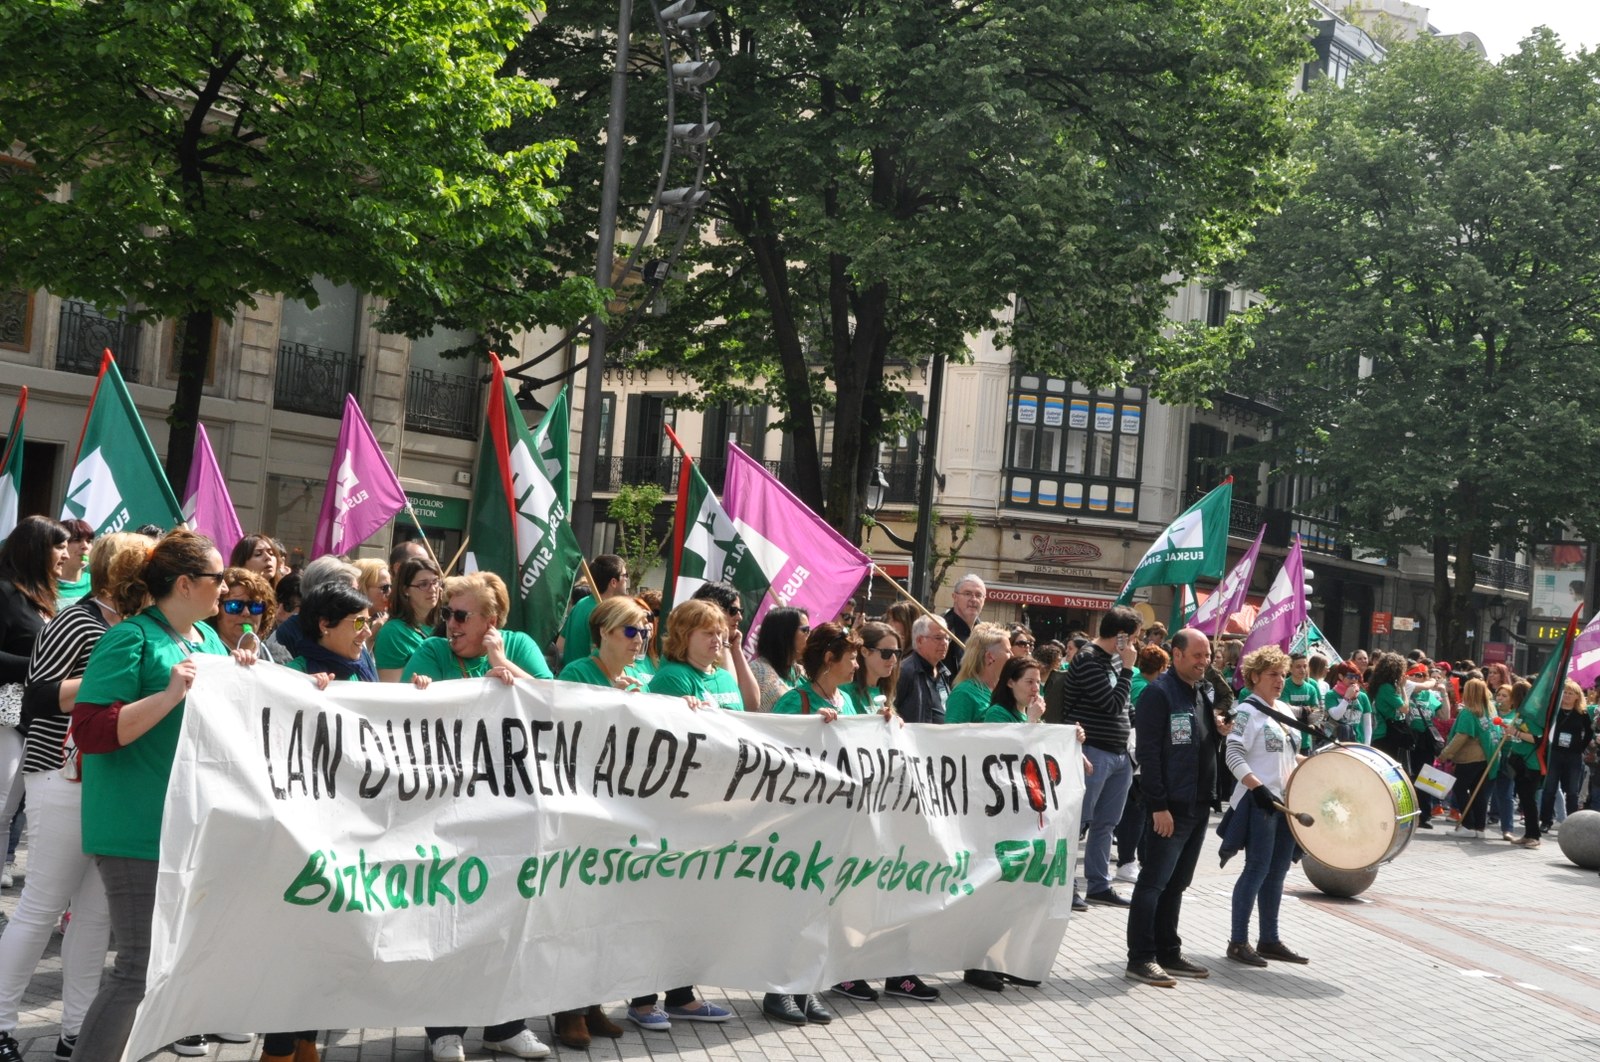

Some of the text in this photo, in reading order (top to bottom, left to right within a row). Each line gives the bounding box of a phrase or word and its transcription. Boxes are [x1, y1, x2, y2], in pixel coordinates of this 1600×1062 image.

[419, 498, 444, 509] COLORS
[988, 591, 1051, 604] GOZOTEGIA
[262, 707, 342, 800] LAN
[359, 717, 582, 801] DUINAREN
[592, 724, 706, 799] ALDE
[982, 753, 1062, 817] STOP
[283, 845, 489, 913] Bizkaiko
[516, 832, 833, 899] erresidentziak
[995, 838, 1067, 887] ELA
